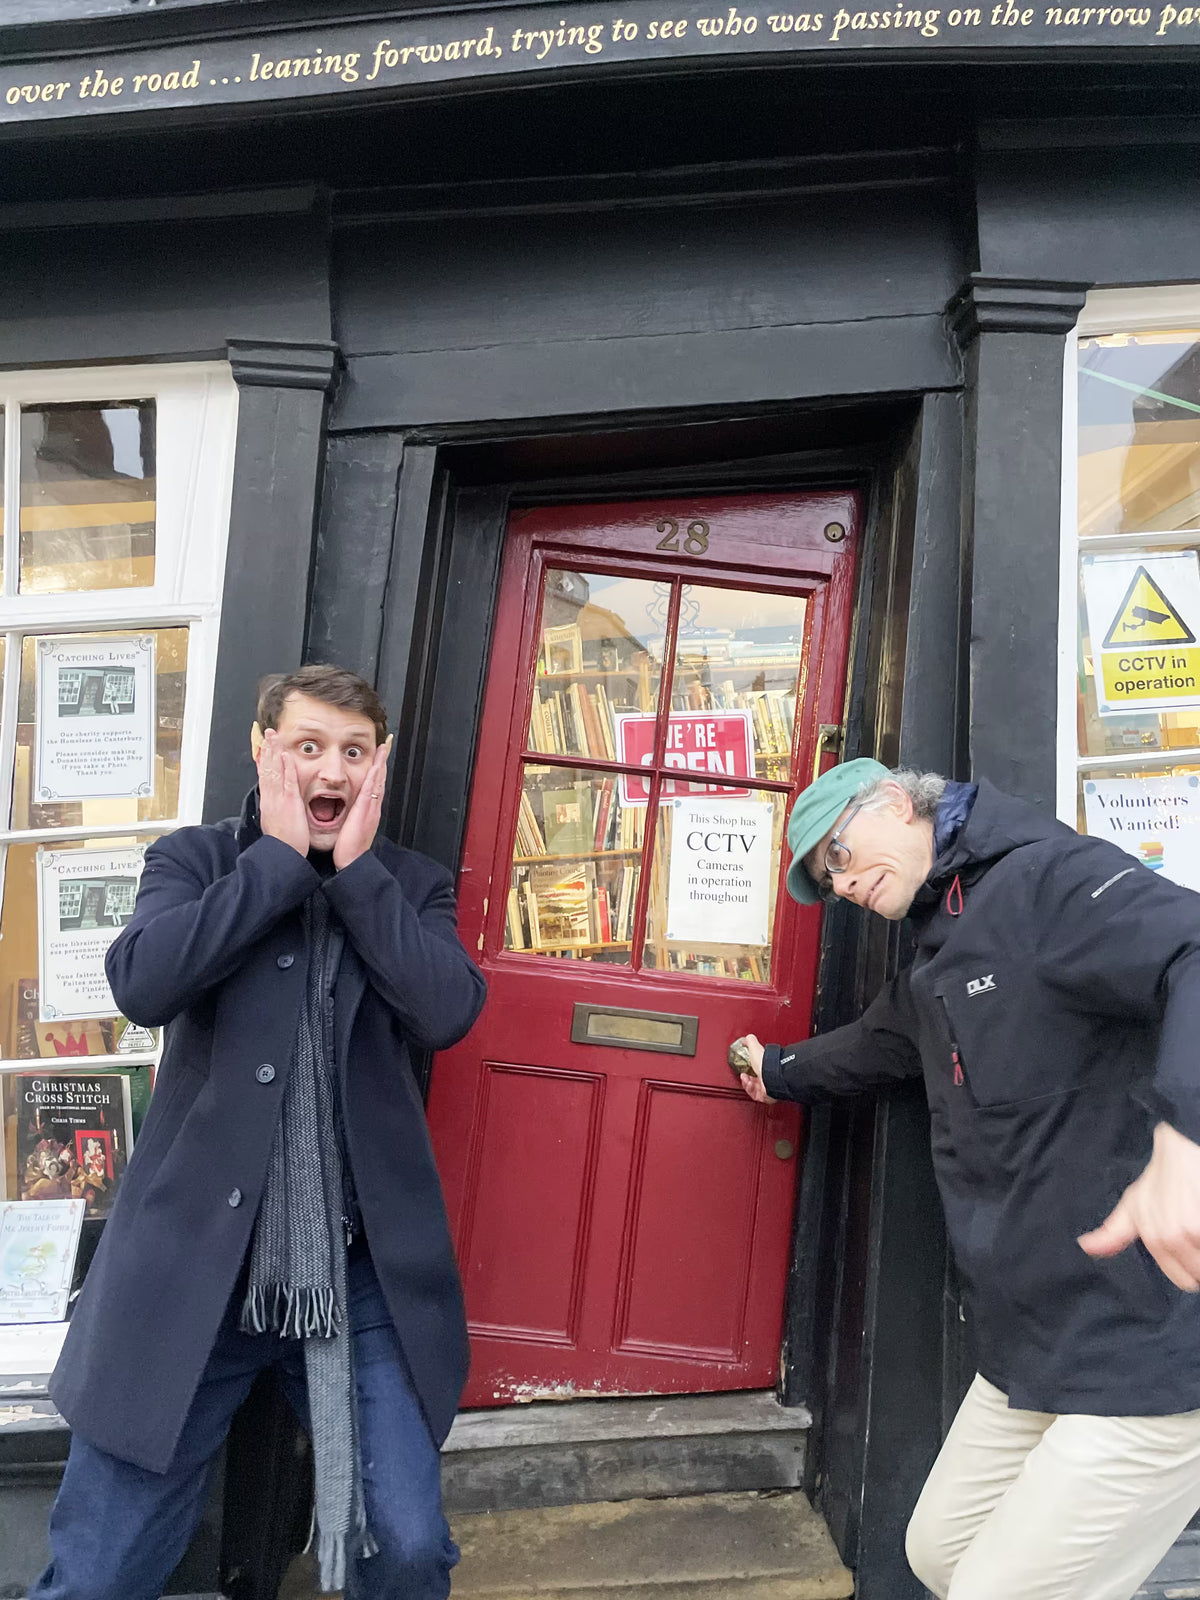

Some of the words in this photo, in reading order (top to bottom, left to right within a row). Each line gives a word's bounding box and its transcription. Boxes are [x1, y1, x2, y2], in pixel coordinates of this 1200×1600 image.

[6, 81, 71, 105] over
[79, 70, 124, 98] the
[132, 60, 201, 93] road
[249, 48, 361, 82] leaning
[366, 27, 502, 80] forward,
[511, 20, 604, 60] trying
[612, 19, 638, 42] to
[646, 19, 688, 40] see
[696, 8, 758, 36] who
[767, 13, 824, 33] was
[829, 3, 941, 41] passing
[948, 7, 981, 26] on
[991, 0, 1034, 26] the
[1045, 6, 1151, 26] narrow
[656, 518, 711, 555] 28
[1118, 656, 1166, 672] CCTV
[1171, 655, 1187, 669] in
[1114, 675, 1195, 694] operation
[75, 730, 100, 738] charity
[1097, 793, 1189, 809] Volunteers
[688, 813, 710, 824] This
[713, 814, 738, 828] Shop
[740, 816, 757, 827] has
[1109, 815, 1180, 831] Wanted!
[686, 831, 757, 853] CCTV
[697, 858, 744, 871] Cameras
[688, 873, 698, 885] in
[701, 876, 752, 888] operation
[690, 889, 748, 904] throughout
[967, 973, 996, 995] DLX
[32, 1080, 101, 1092] CHRISTMAS
[25, 1092, 63, 1103] CROSS
[66, 1092, 110, 1104] STITCH
